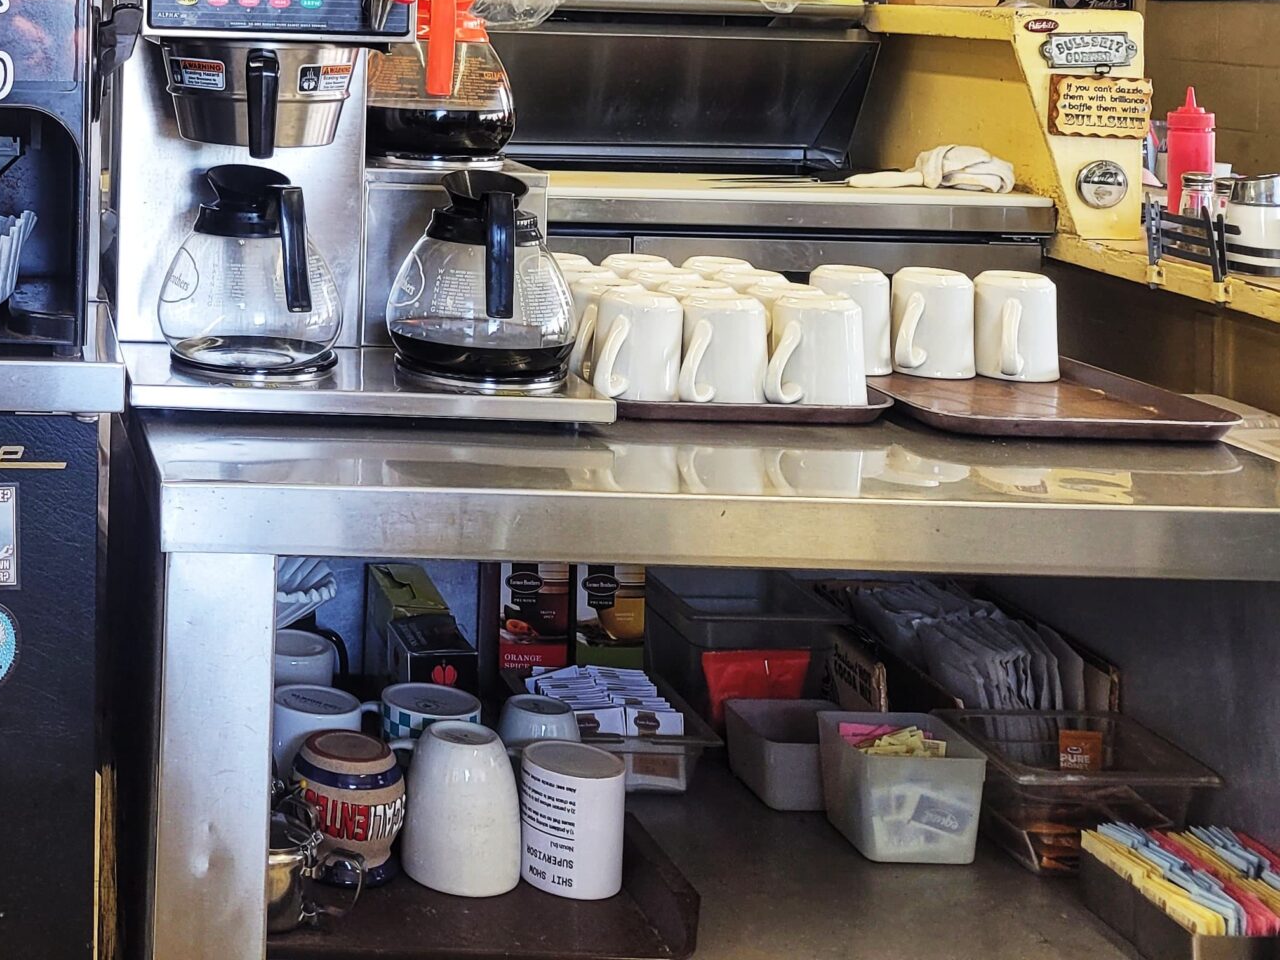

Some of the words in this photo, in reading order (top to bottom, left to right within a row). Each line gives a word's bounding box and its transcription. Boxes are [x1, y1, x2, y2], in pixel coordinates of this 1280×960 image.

[187, 62, 221, 71] WARNING
[1067, 83, 1072, 92] If
[1075, 85, 1089, 93] you
[1063, 93, 1083, 101] them
[1088, 94, 1106, 102] with
[1068, 102, 1092, 111] baffle
[1097, 104, 1117, 112] them
[1121, 105, 1139, 113] with
[1064, 113, 1145, 129] BULLSHIT
[504, 653, 543, 662] ORANGE
[1060, 754, 1090, 764] PURE
[559, 843, 574, 852] Noun
[526, 843, 574, 869] SUPERVISOR
[529, 864, 547, 880] SHOW
[551, 874, 573, 887] SHIT
